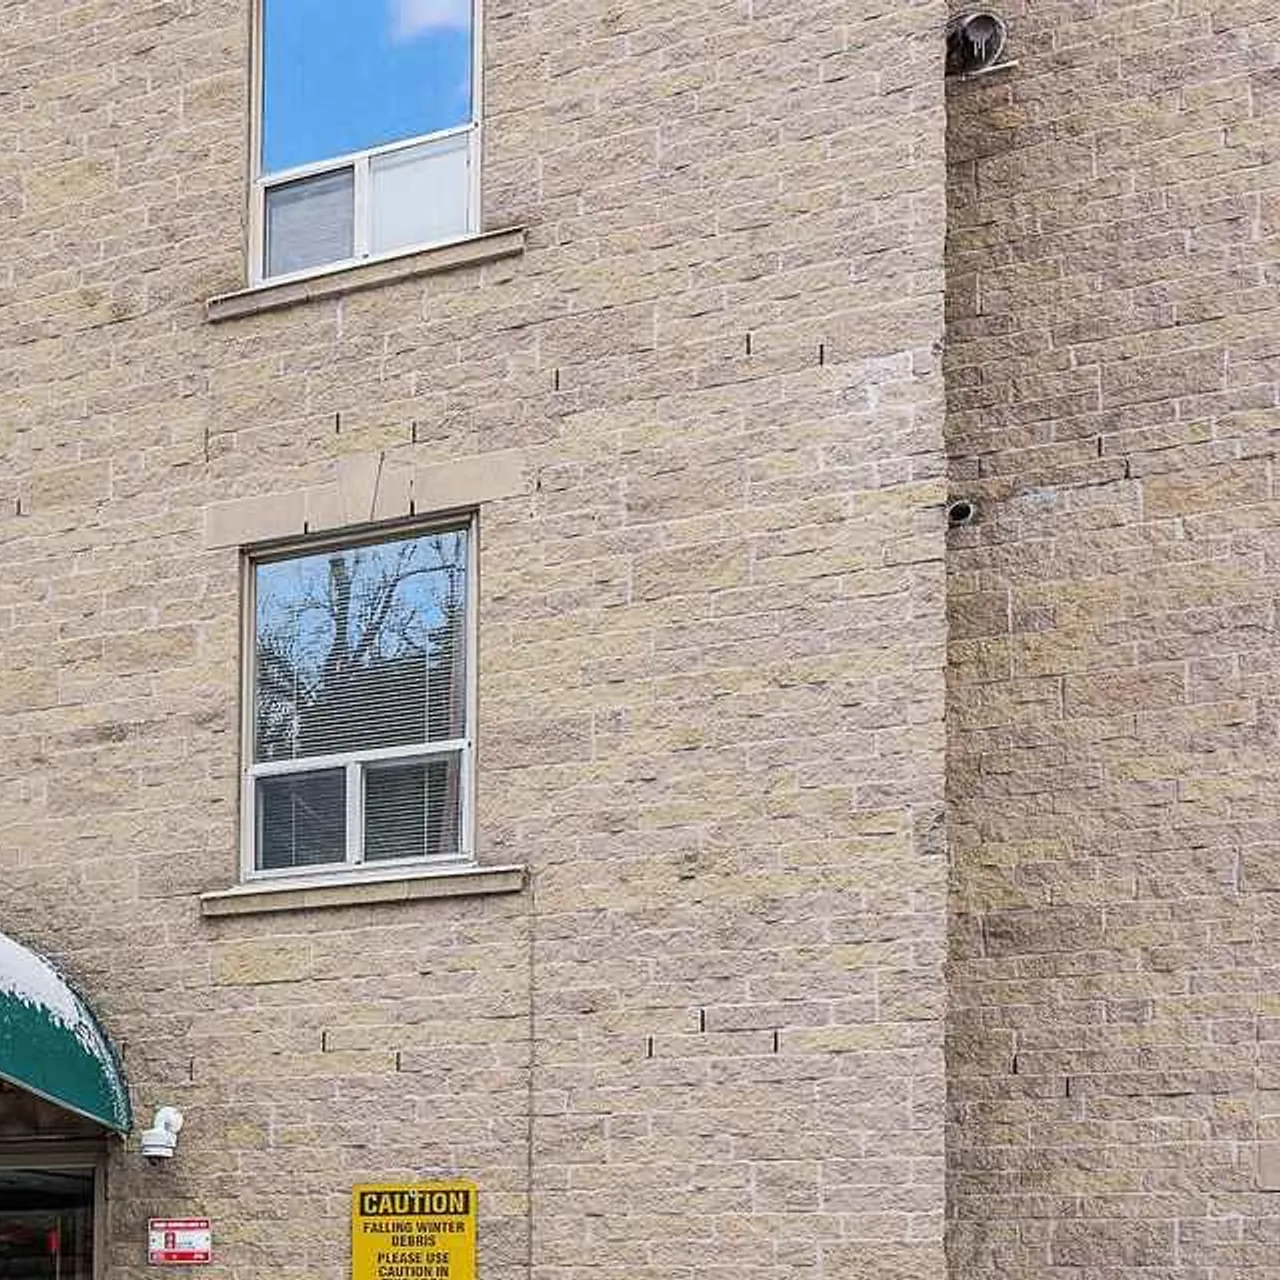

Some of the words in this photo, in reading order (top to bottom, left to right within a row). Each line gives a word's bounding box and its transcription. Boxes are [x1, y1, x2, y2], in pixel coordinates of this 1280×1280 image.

[363, 1192, 465, 1214] CAUTION
[363, 1222, 412, 1234] FALLING
[416, 1222, 465, 1234] WINTER
[391, 1235, 436, 1247] DEBRIS
[377, 1252, 421, 1264] PLEASE
[426, 1252, 449, 1264] USE
[378, 1266, 432, 1278] CAUTION
[436, 1266, 449, 1278] IN
